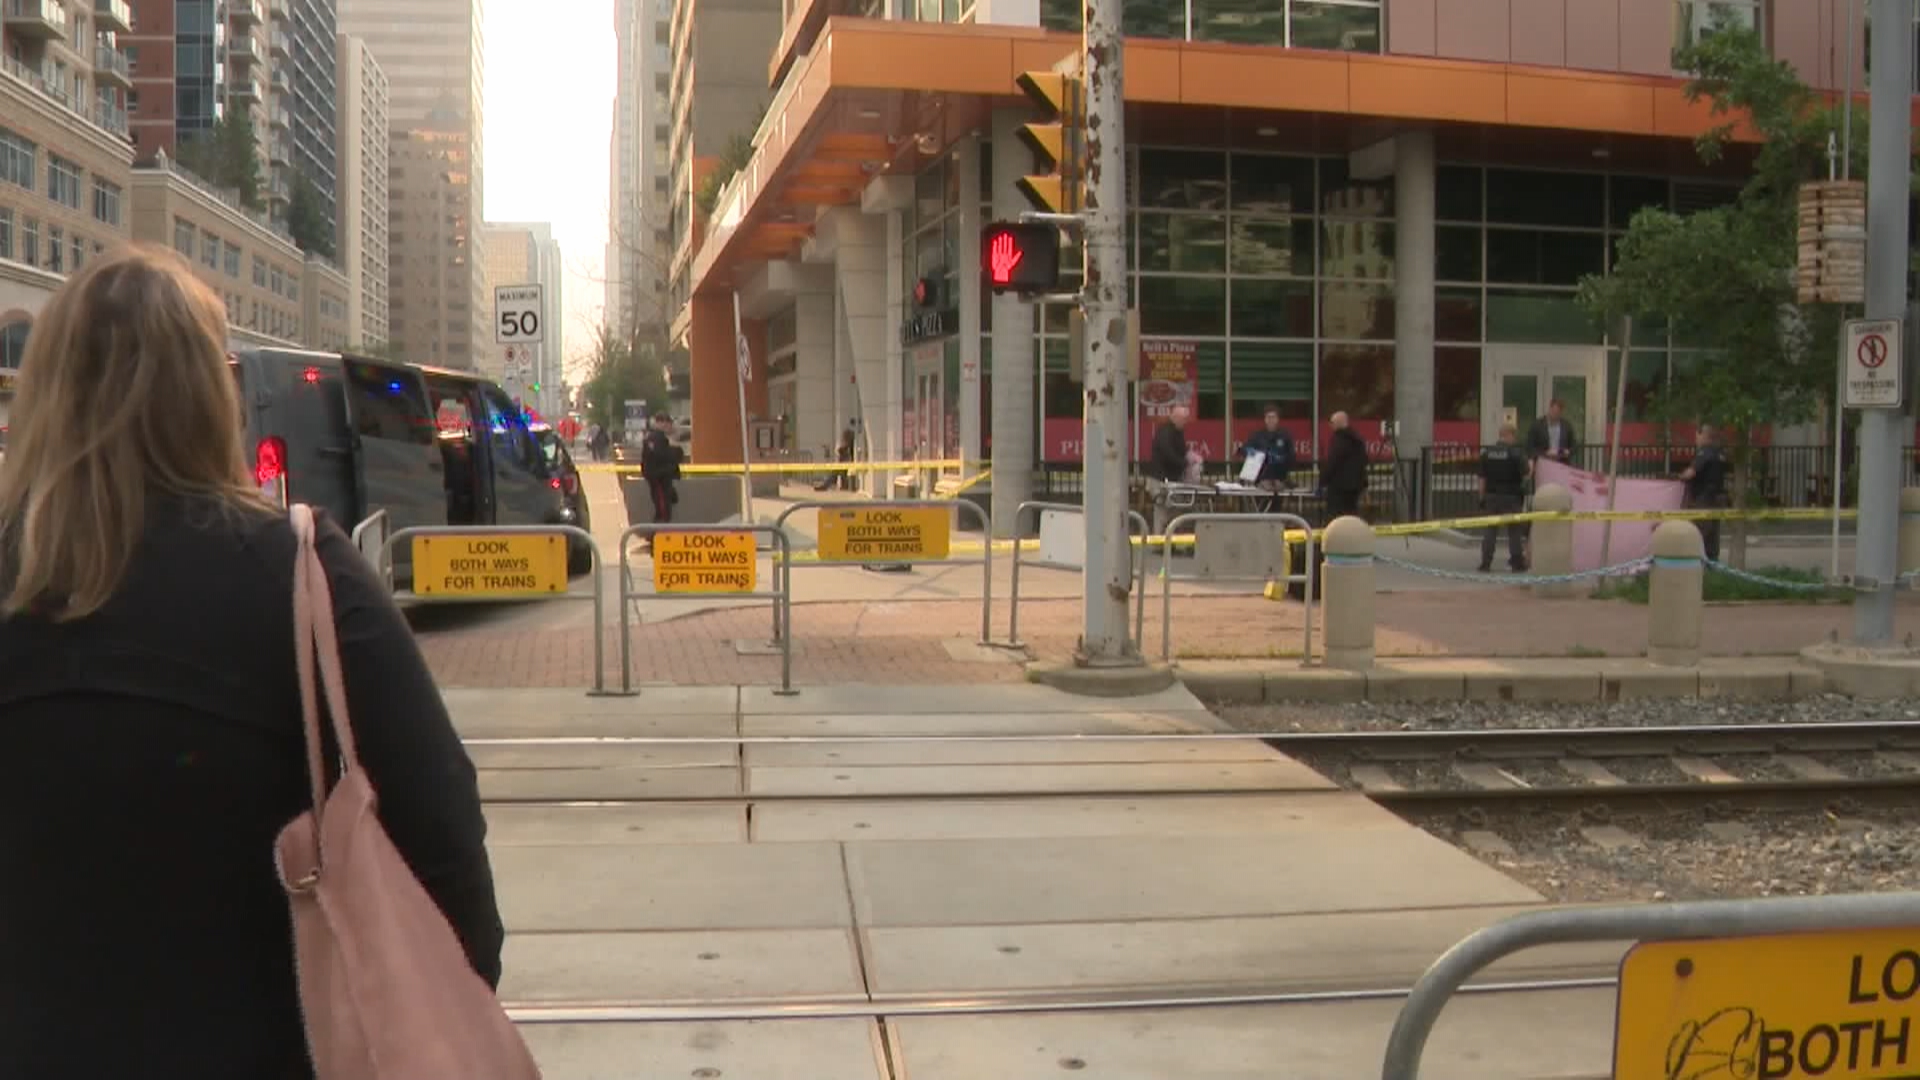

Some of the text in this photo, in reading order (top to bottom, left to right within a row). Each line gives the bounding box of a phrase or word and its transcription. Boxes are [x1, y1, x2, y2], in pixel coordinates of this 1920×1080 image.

[501, 311, 538, 336] 50
[866, 511, 902, 523] LOOK
[848, 525, 920, 536] BOTH WAYS
[468, 541, 509, 554] LOOK
[684, 535, 725, 548] LOOK
[845, 543, 922, 553] FOR TRAINS
[450, 558, 528, 570] BOTH WAYS
[662, 551, 747, 564] BOTH WAYS
[444, 575, 536, 589] FOR TRAINS
[660, 573, 750, 584] FOR TRAINS
[1848, 950, 1920, 1004] LO
[1759, 1017, 1910, 1079] BOTH
